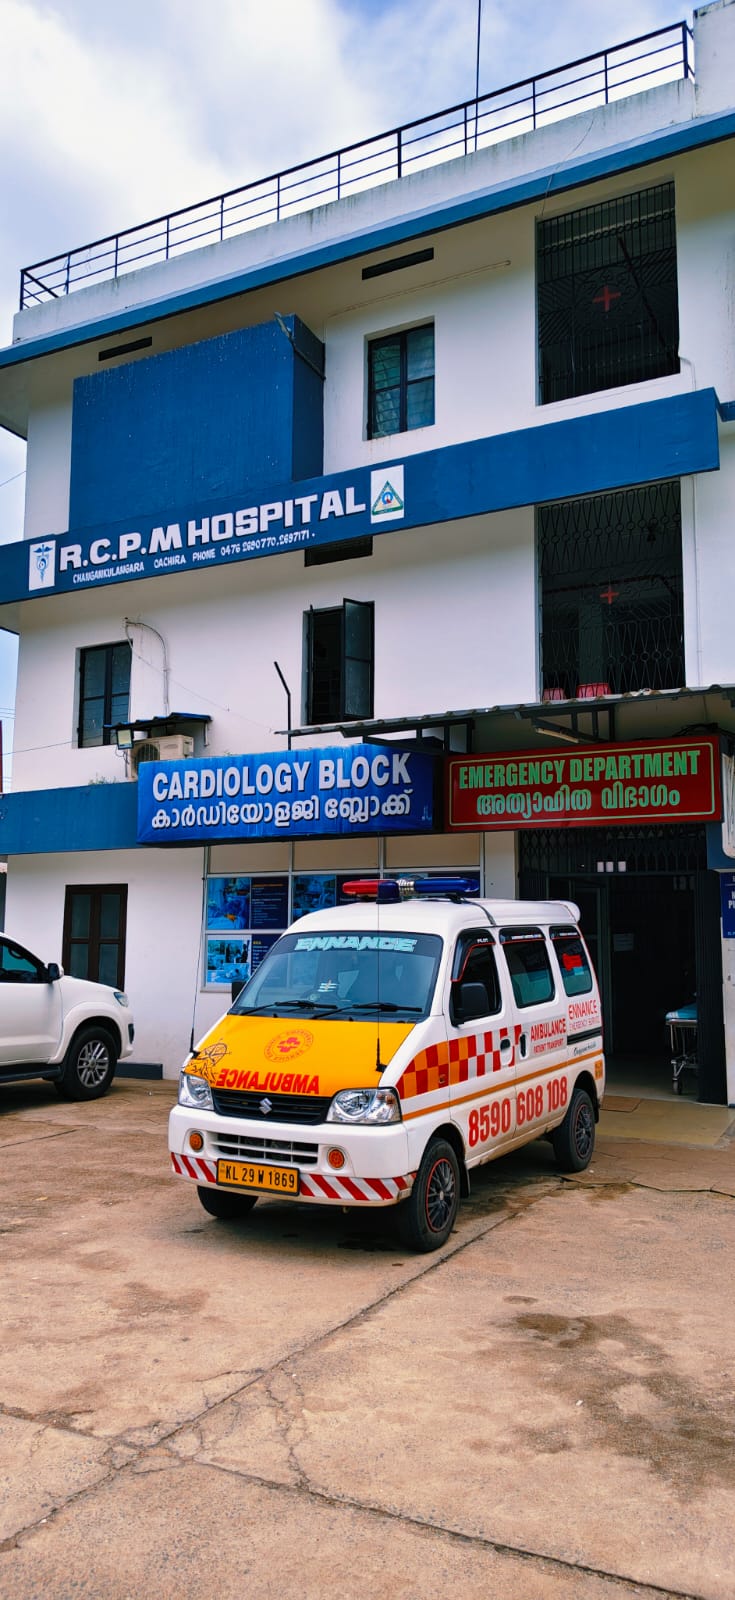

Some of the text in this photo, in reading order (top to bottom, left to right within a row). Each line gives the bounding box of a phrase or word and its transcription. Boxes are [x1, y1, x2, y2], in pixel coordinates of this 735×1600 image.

[59, 486, 366, 571] R.C.P.M HOSPITAL
[192, 548, 216, 562] PHONE
[220, 543, 240, 557] 0476
[152, 752, 412, 802] CARDIOLOGY BLOCK
[459, 750, 700, 789] EMERGENCY DEPARTMENT
[476, 781, 681, 819] അത്യാഹിത വിഭാഗം
[568, 1000, 597, 1020] ENNANCE
[530, 1018, 566, 1042] AMBULANCE
[468, 1076, 568, 1147] 8590 608 108
[225, 1165, 238, 1181] KL
[241, 1167, 255, 1183] 29
[268, 1171, 295, 1189] 1869
